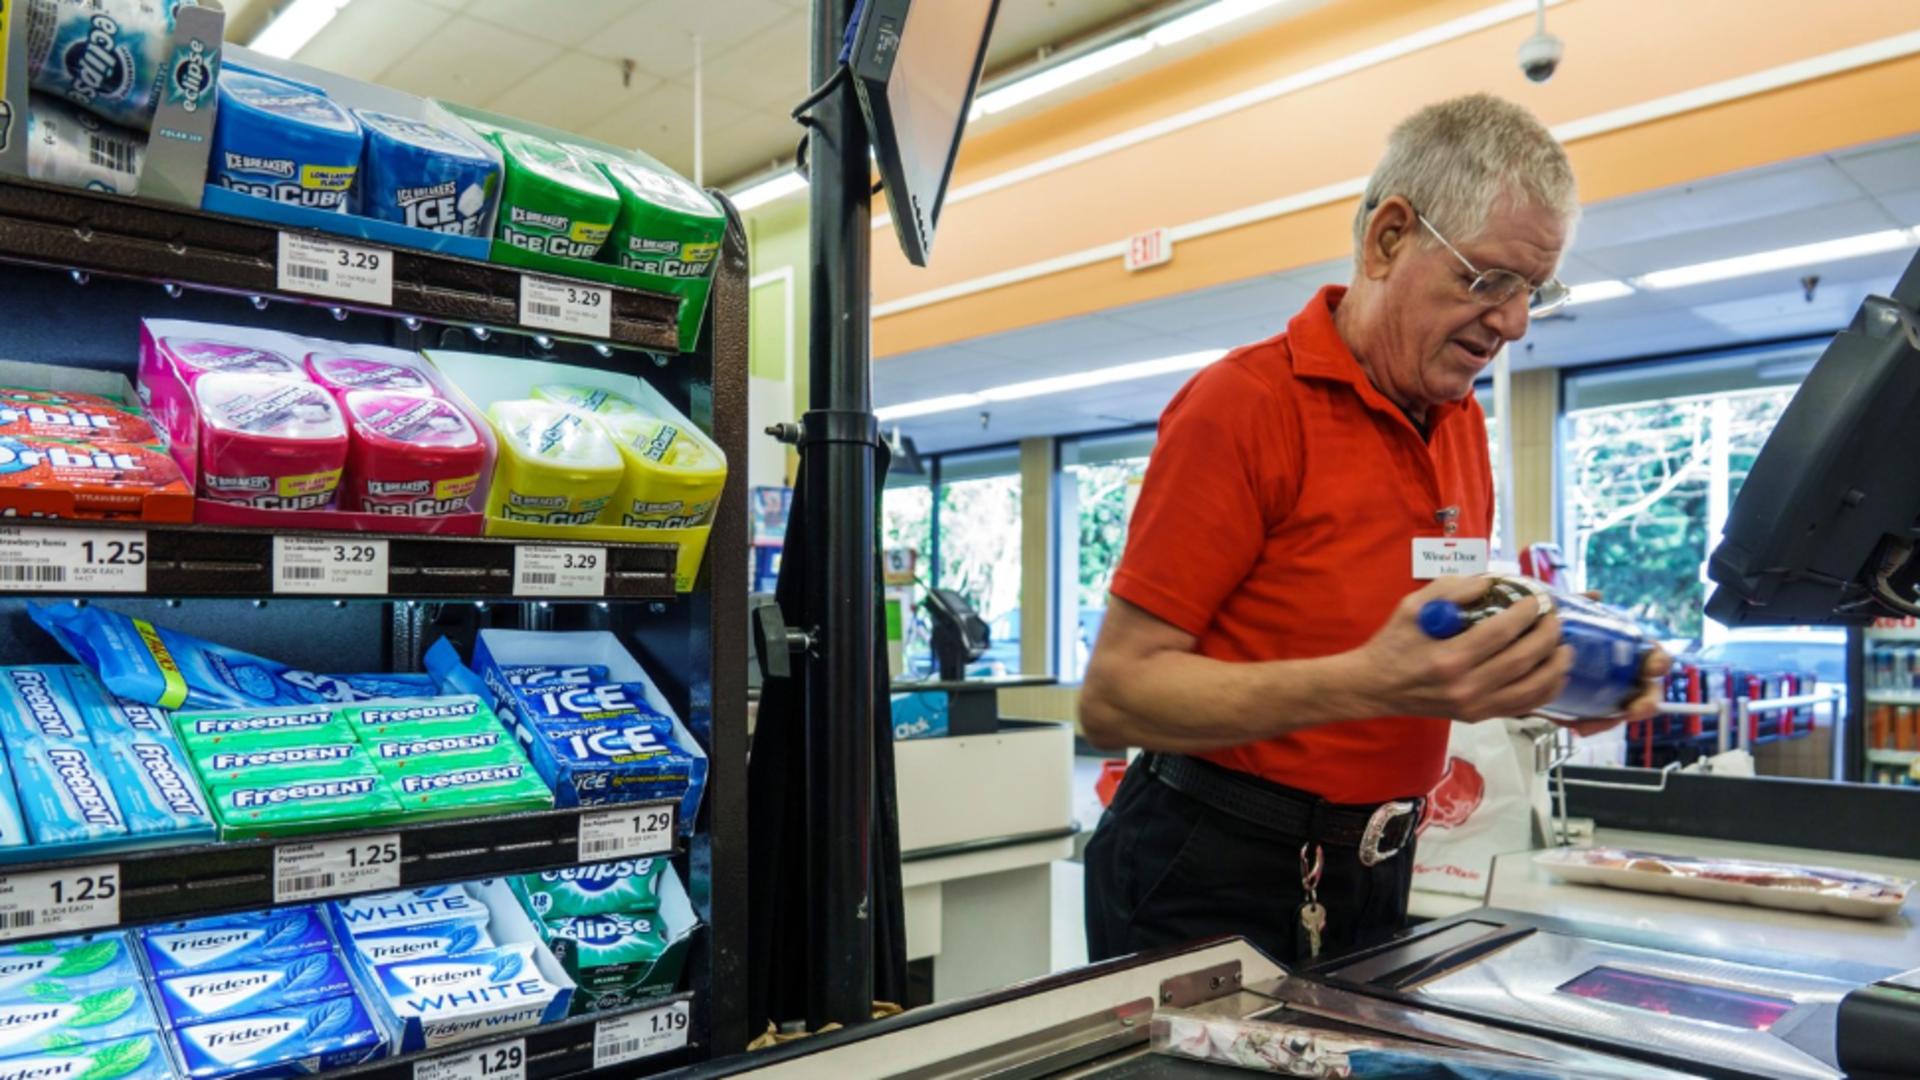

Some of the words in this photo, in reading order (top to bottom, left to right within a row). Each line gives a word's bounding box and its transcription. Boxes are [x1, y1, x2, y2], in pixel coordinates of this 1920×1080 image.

[183, 39, 204, 112] eclipse
[243, 156, 295, 177] BREAKERS
[405, 197, 456, 227] ICE
[1132, 230, 1162, 266] EXIT
[338, 249, 379, 270] 3.29
[567, 288, 601, 307] 3.29
[0, 406, 118, 429] rbit
[75, 493, 141, 502] STRAWBERRY
[0, 528, 20, 536] rbit
[0, 538, 40, 548] trawberry
[82, 541, 145, 564] 1.25
[334, 545, 375, 562] 3.29
[563, 553, 597, 569] 3.29
[541, 684, 637, 715] ICE
[117, 701, 162, 731] ENT
[569, 725, 668, 759] ICE
[632, 812, 670, 833] 1.29
[346, 843, 398, 868] 1.25
[541, 857, 655, 881] eclipse
[50, 875, 116, 904] 1.25
[342, 896, 470, 923] WHITE
[532, 894, 548, 907] 18
[168, 931, 250, 952] Trident
[370, 939, 439, 958] Trident
[0, 960, 44, 974] ent
[410, 967, 483, 987] Trident
[184, 974, 269, 997] Trident
[407, 979, 546, 1012] WHITE
[0, 1009, 59, 1026] dent
[424, 1017, 484, 1037] Trident
[650, 1012, 687, 1033] 1.19
[205, 1022, 292, 1048] Trident
[0, 1062, 72, 1080] ident
[479, 1046, 522, 1076] 1.29
